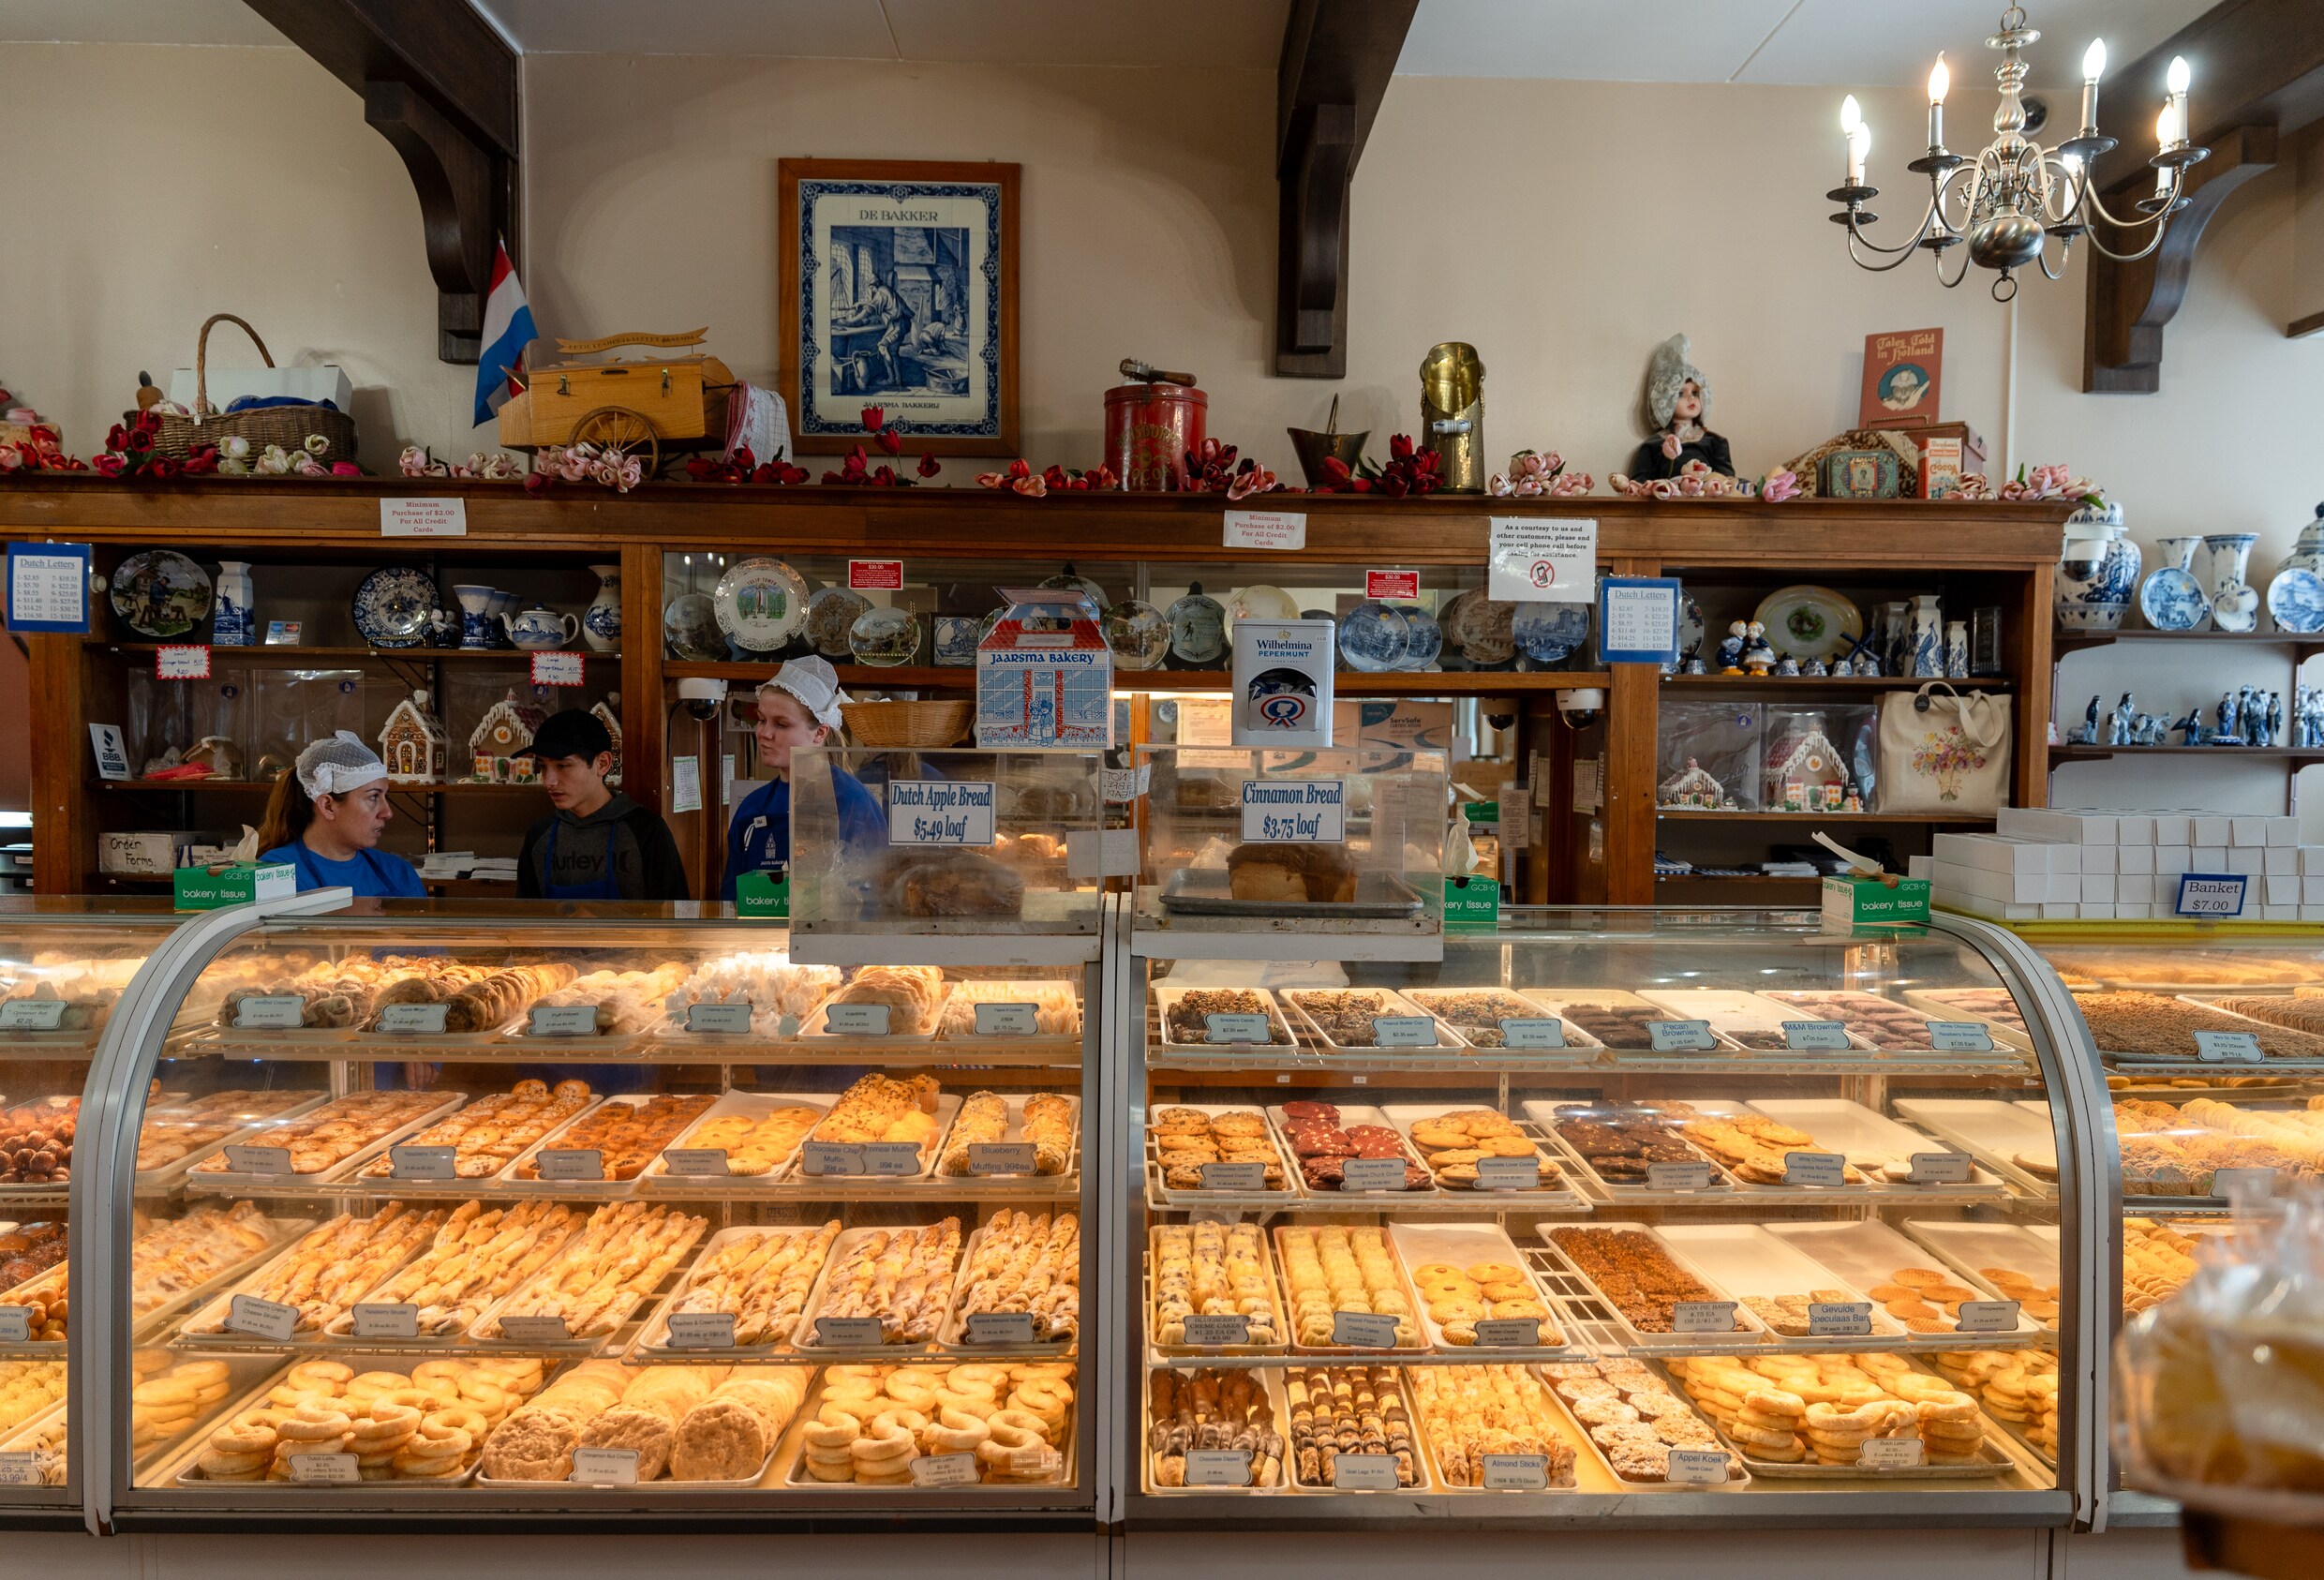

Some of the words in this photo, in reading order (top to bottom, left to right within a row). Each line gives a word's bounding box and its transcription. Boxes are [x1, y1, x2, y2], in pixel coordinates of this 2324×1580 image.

[859, 210, 877, 220] DE
[883, 211, 938, 221] BAKKER
[1876, 336, 1906, 350] Tales
[1911, 333, 1935, 346] Told
[1877, 349, 1887, 358] in
[1887, 346, 1934, 365] Holland
[48, 559, 75, 568] Letters
[1640, 590, 1667, 599] Letters
[1257, 640, 1312, 649] Wilhelmina
[991, 653, 1045, 664] JAARSMA
[1050, 652, 1095, 665] BAKERY
[102, 753, 120, 761] BBB
[892, 783, 923, 806] Dutch
[926, 785, 956, 812] Apple
[958, 783, 991, 806] Bread
[1244, 782, 1303, 804] Cinnamon
[1305, 782, 1341, 804] Bread
[914, 815, 943, 841] $5.49
[945, 815, 967, 842] loaf
[1263, 813, 1294, 839] $3.75
[1296, 812, 1321, 840] loaf
[111, 838, 142, 850] Order
[257, 870, 274, 881] bakery
[276, 869, 290, 879] tissue
[2189, 882, 2239, 893] Banket
[183, 889, 216, 901] bakery
[221, 889, 246, 898] tissue
[746, 896, 780, 906] bakery
[1467, 901, 1491, 909] tissue
[1861, 902, 1894, 910] bakery
[1898, 900, 1923, 908] tissue
[2193, 900, 2228, 911] $7.00
[844, 1146, 858, 1155] Chip
[1822, 1304, 1855, 1313] Gevulde
[1810, 1315, 1851, 1323] Speculaas
[1853, 1314, 1871, 1322] Bars
[1677, 1453, 1700, 1463] Appel
[1702, 1454, 1722, 1464] Koek
